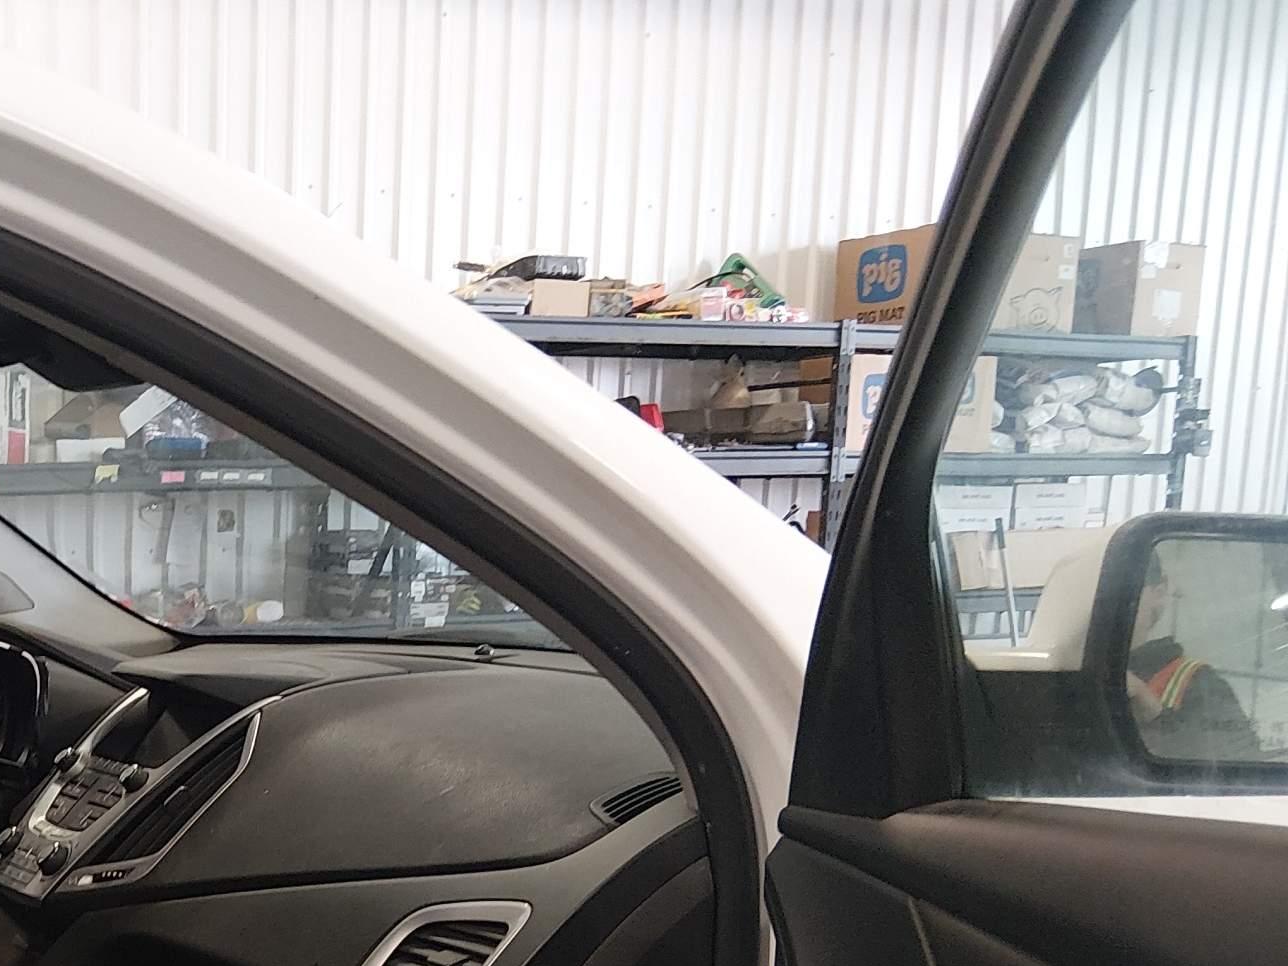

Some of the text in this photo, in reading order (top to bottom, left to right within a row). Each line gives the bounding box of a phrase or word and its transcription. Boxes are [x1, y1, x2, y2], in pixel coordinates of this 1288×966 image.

[862, 253, 903, 297] pig
[857, 306, 905, 324] PIG MAT
